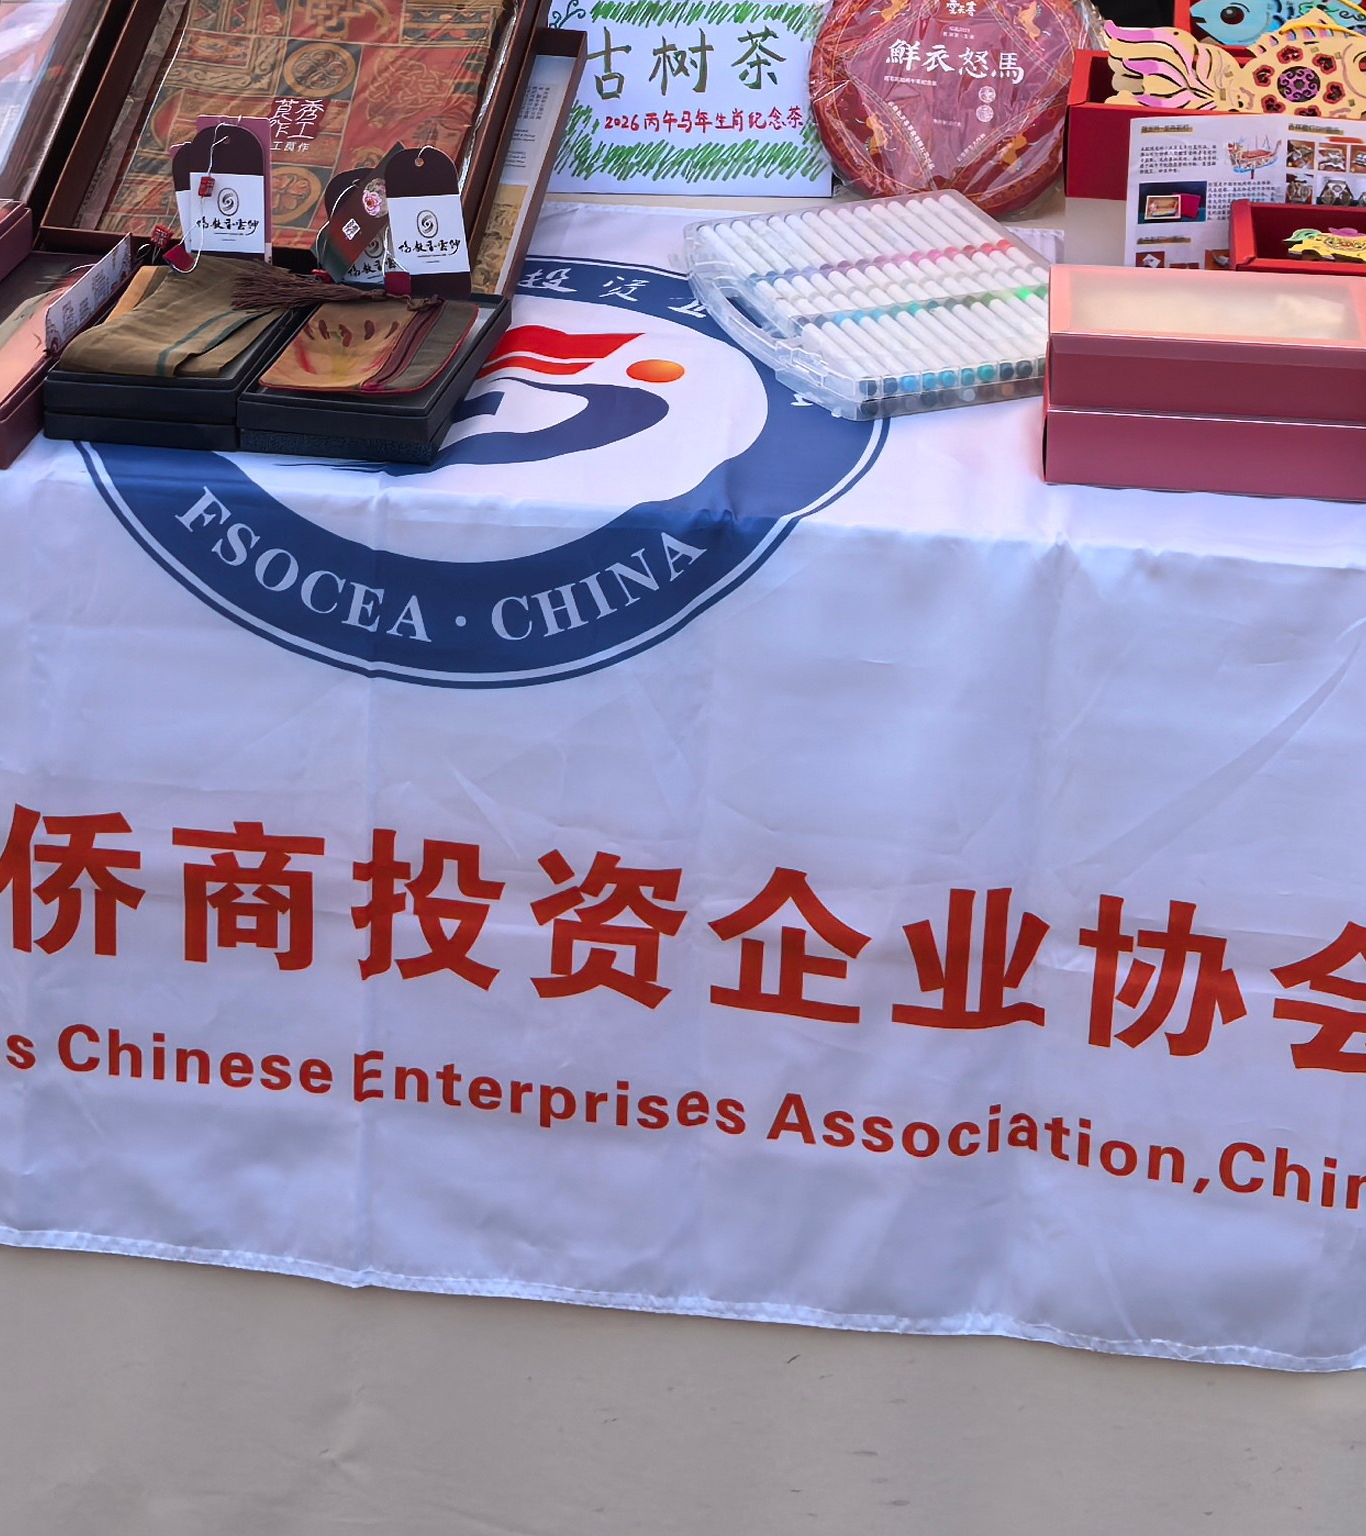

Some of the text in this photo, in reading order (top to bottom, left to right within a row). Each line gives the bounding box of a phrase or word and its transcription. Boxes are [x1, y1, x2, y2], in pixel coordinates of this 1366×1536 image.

[586, 26, 787, 100] 古树茶
[175, 485, 708, 644] FSOCEA CHINA
[58, 1024, 333, 1094] Chinese
[354, 1051, 747, 1135] Enterprises
